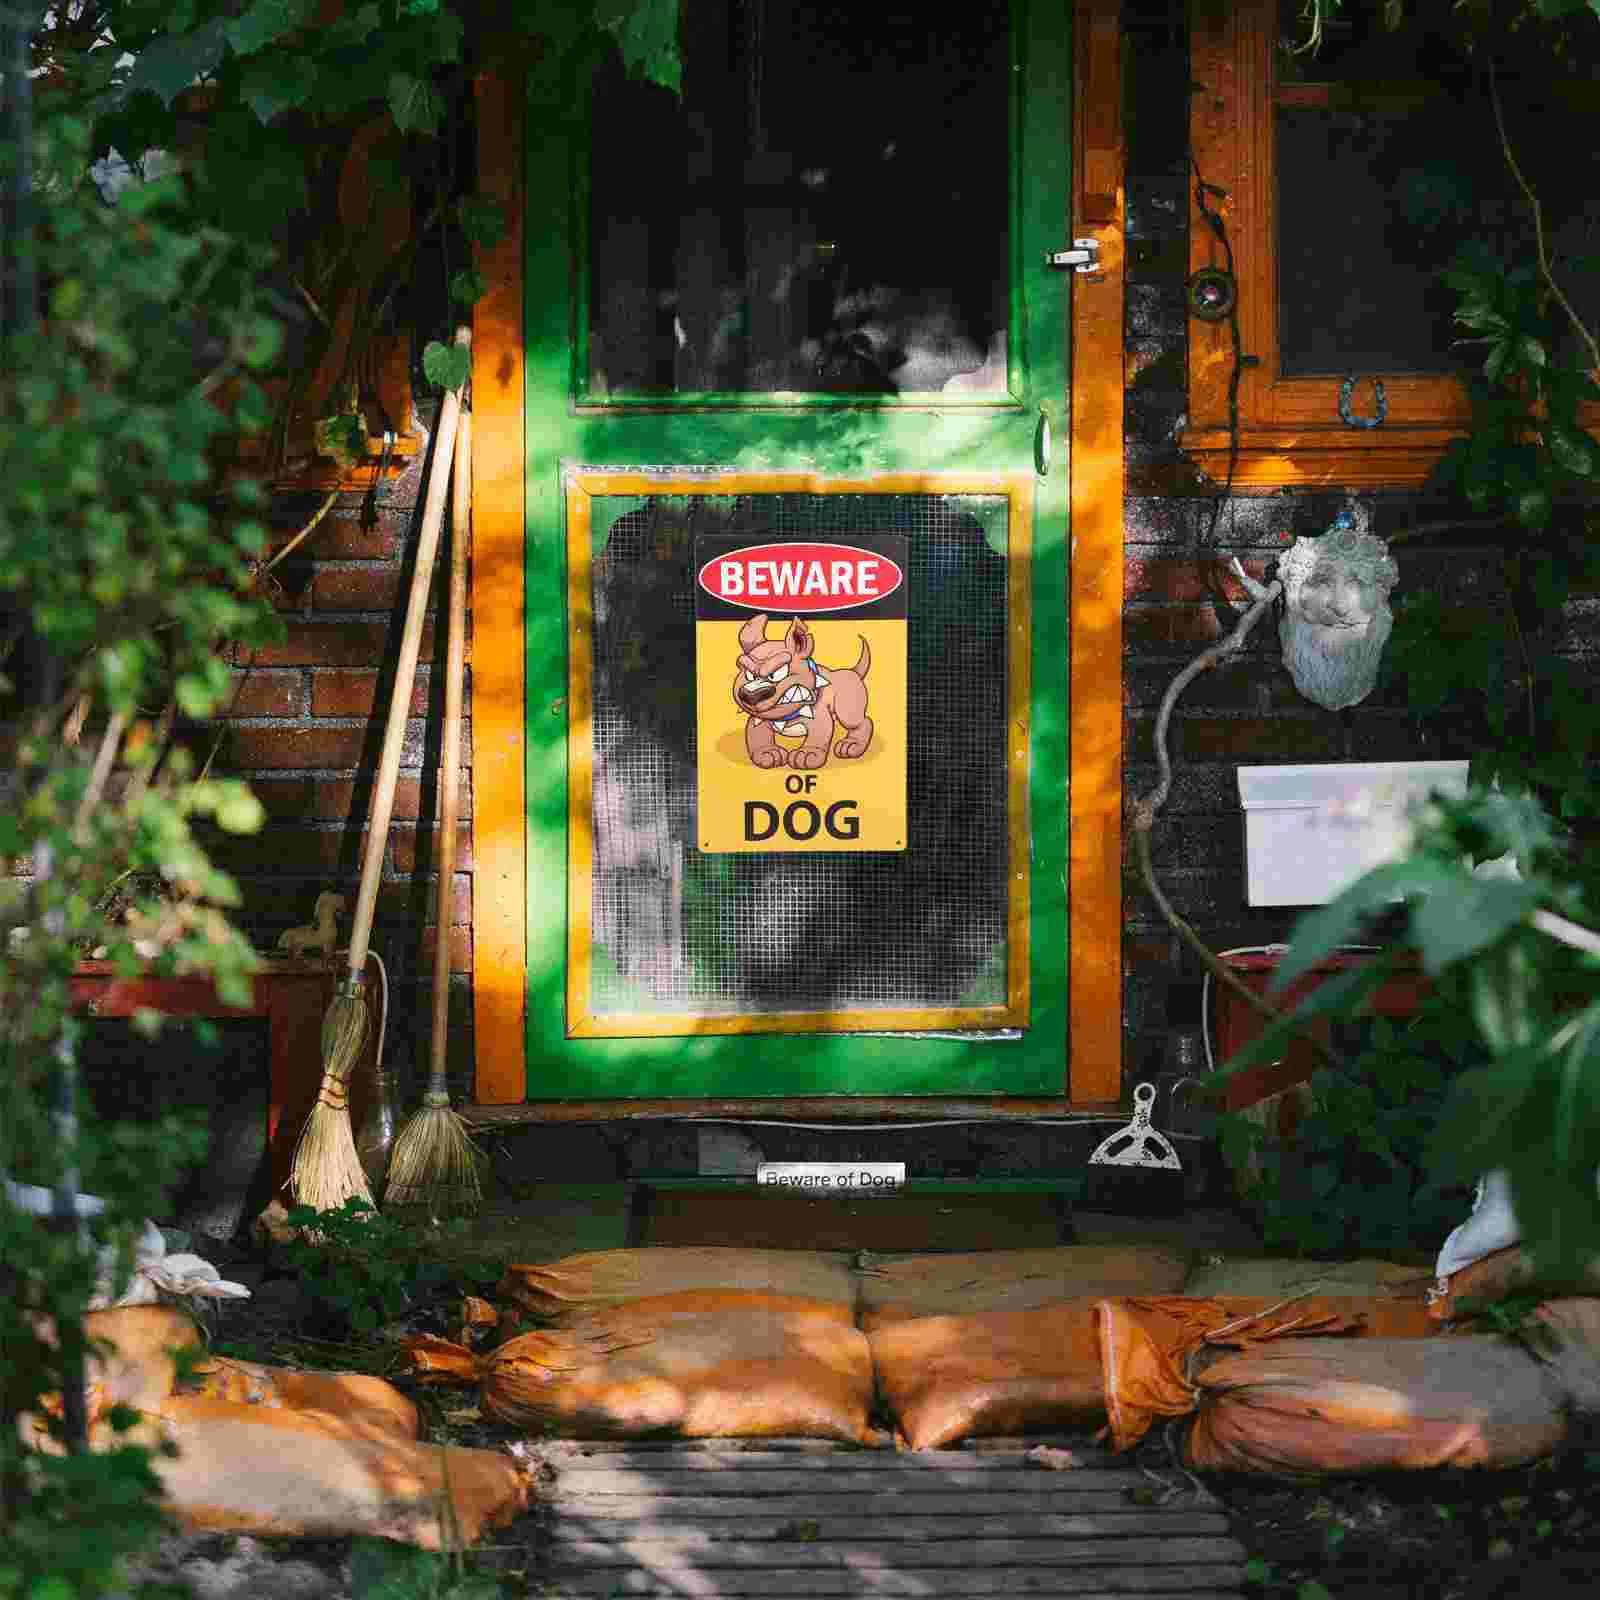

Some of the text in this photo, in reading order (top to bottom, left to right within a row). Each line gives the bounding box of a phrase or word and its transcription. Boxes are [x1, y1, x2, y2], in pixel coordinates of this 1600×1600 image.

[720, 561, 879, 596] BEWARE
[785, 774, 817, 794] OF
[744, 800, 860, 841] DOG
[766, 1171, 896, 1188] Beware of Dog
